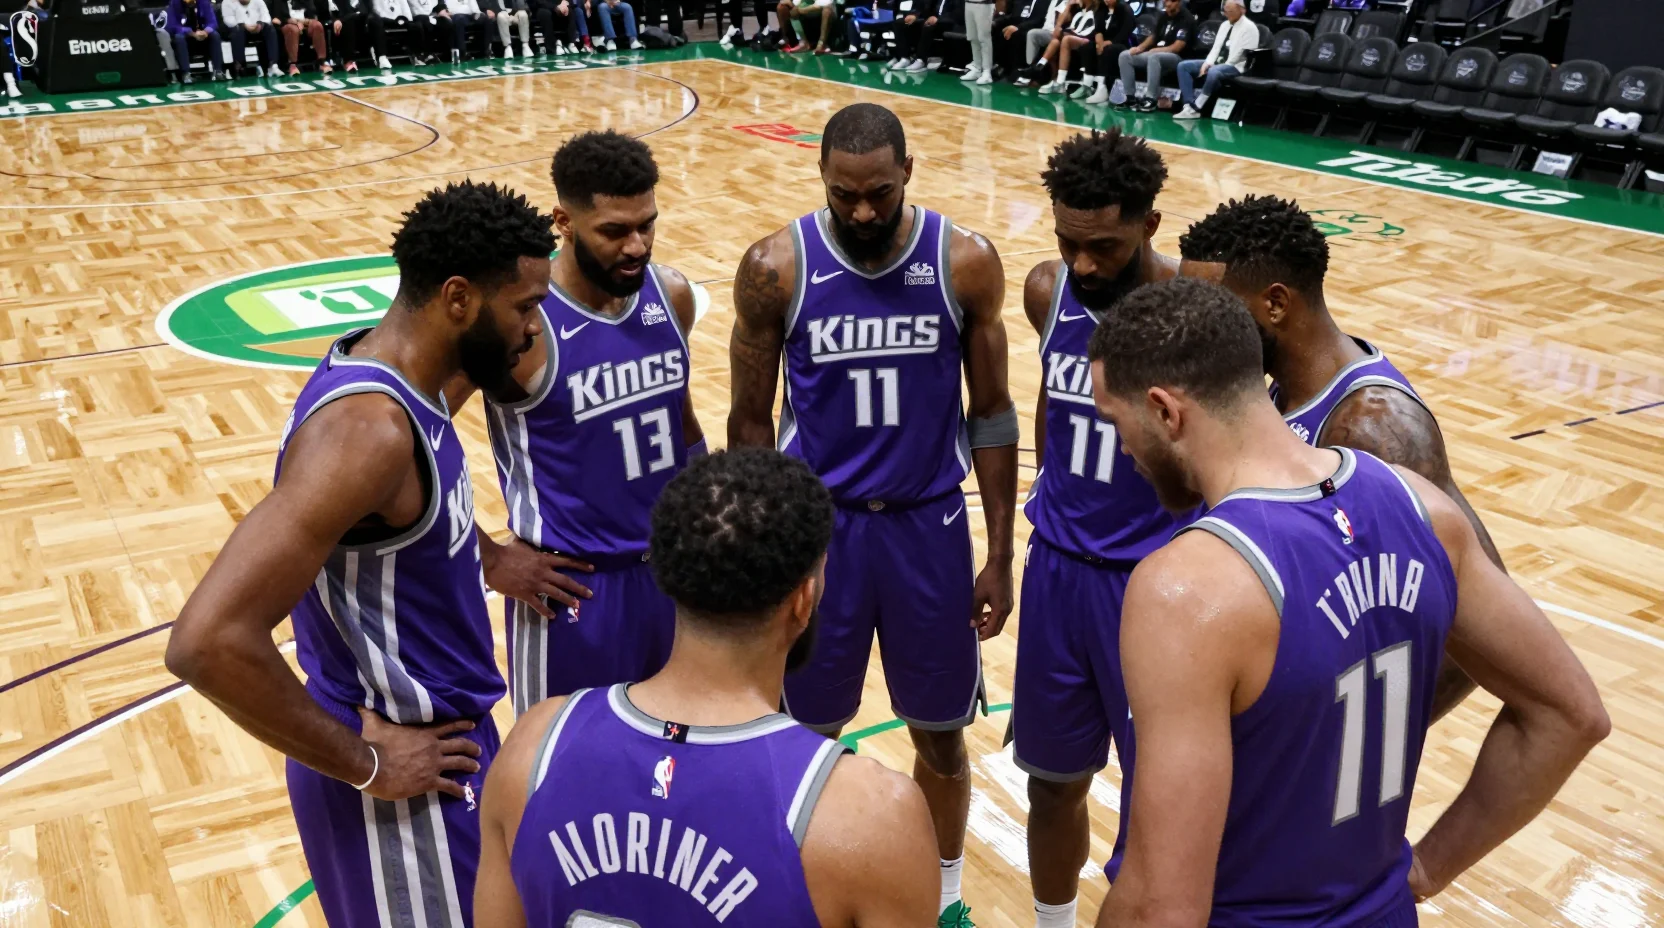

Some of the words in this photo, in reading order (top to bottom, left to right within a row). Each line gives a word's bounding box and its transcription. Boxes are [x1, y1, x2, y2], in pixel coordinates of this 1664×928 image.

[847, 367, 900, 427] 11
[612, 406, 676, 481] 13
[1069, 412, 1116, 484] 11
[1331, 640, 1412, 827] 11
